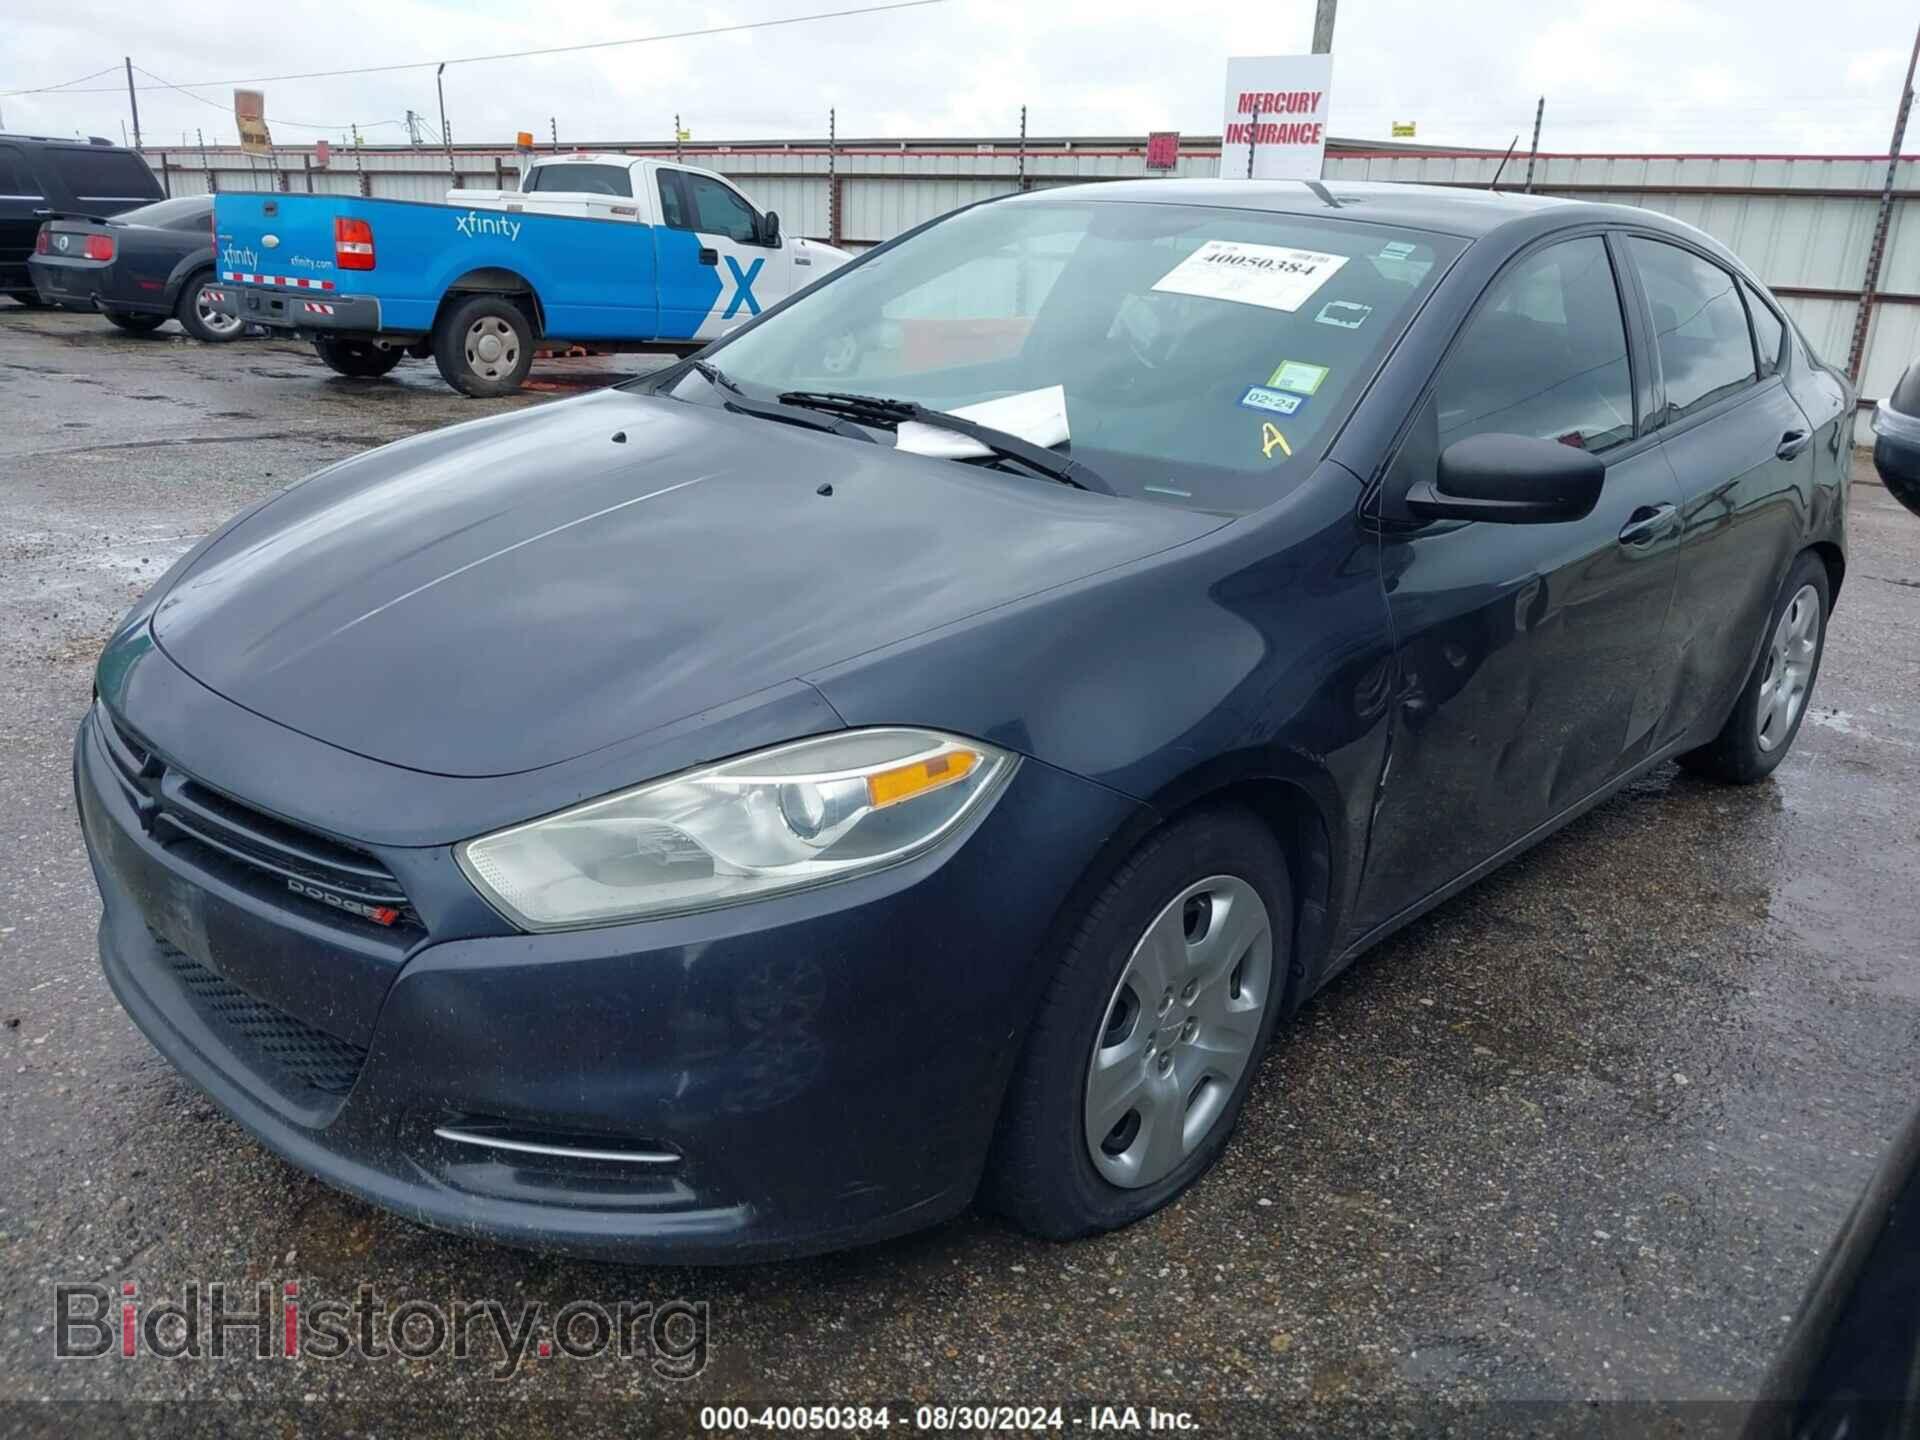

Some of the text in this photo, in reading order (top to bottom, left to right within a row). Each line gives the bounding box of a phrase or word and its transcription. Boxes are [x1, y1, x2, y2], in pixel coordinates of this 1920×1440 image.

[1237, 91, 1322, 114] MERCURY
[1225, 122, 1322, 145] INSURANCE
[456, 211, 521, 241] xfinity
[223, 243, 258, 272] xfinity
[1204, 253, 1318, 276] 40050384
[1262, 422, 1292, 458] A
[287, 879, 382, 920] DODGE
